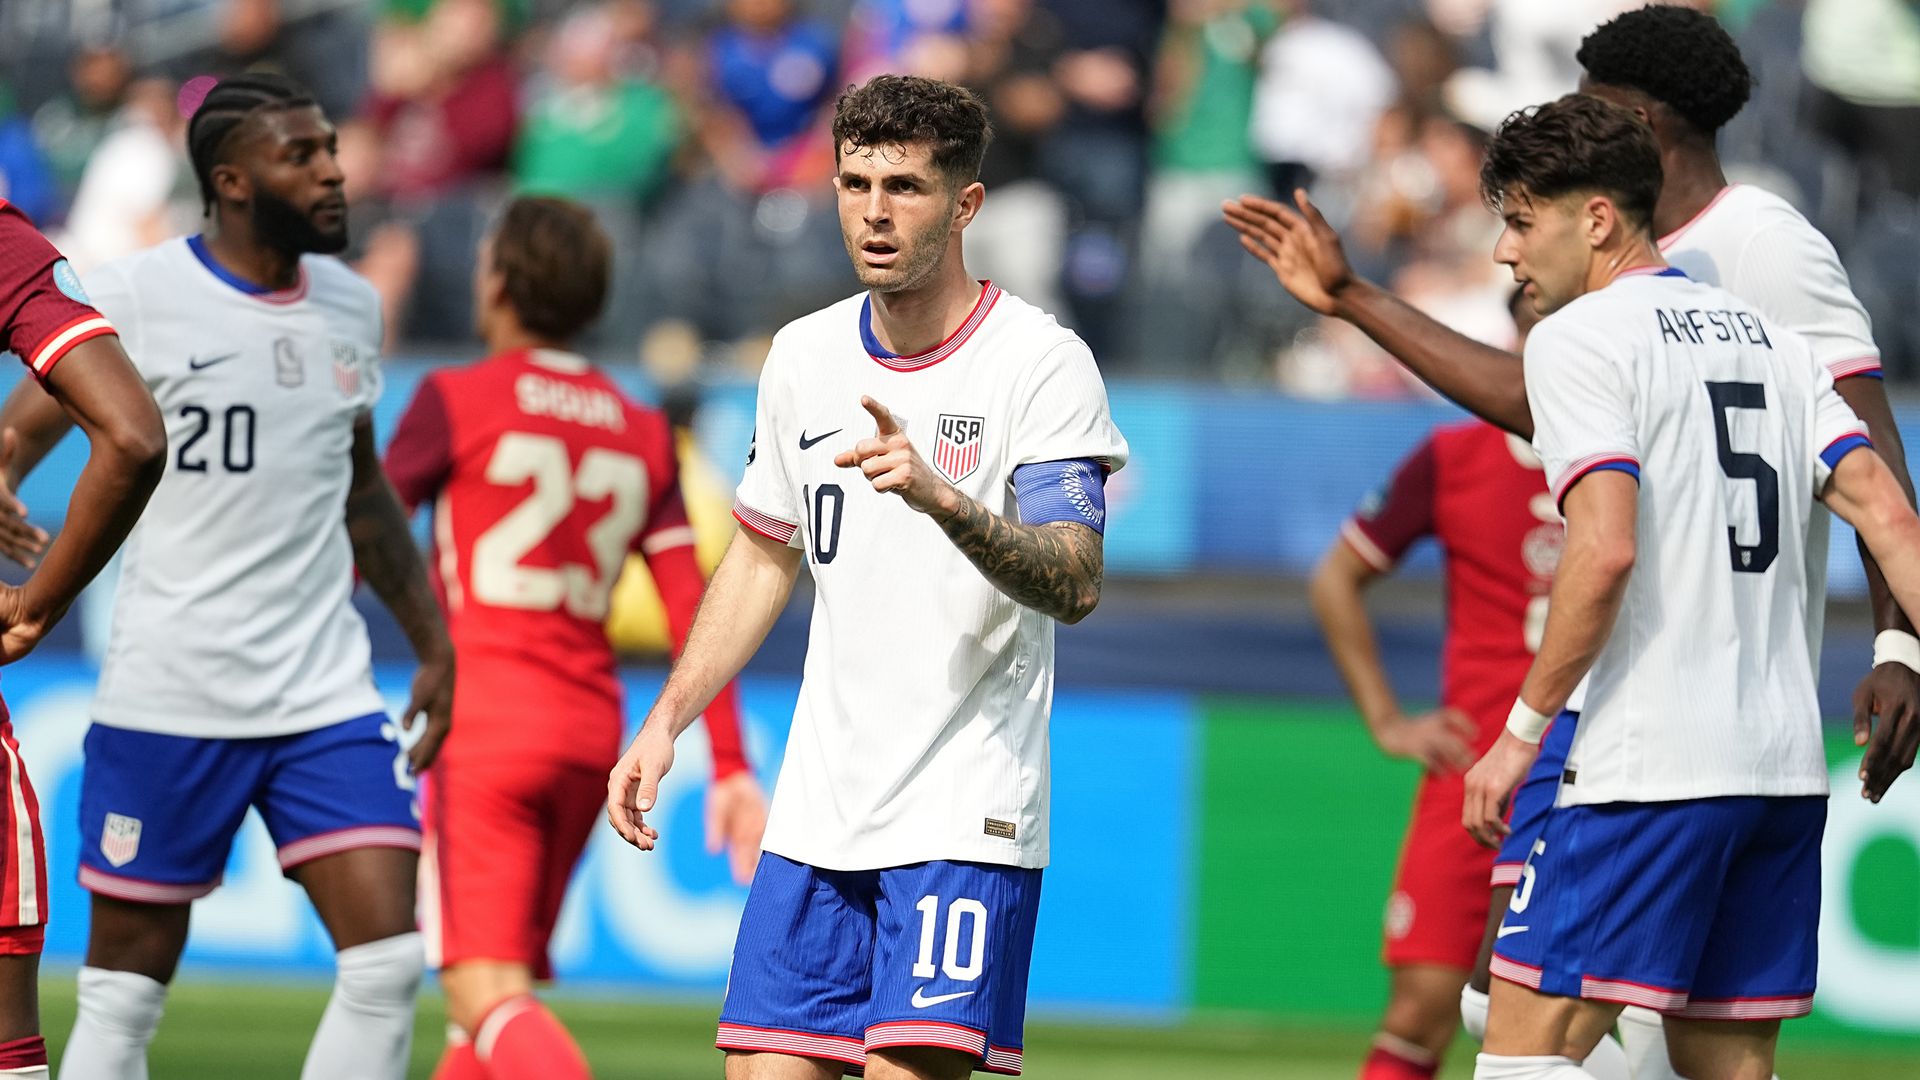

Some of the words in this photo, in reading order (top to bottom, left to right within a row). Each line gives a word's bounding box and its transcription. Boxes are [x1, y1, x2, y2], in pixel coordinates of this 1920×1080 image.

[1656, 308, 1772, 350] ARFSTEN
[177, 406, 255, 472] 20
[941, 418, 980, 445] USA
[1705, 381, 1779, 573] 5
[471, 431, 648, 622] 23
[803, 483, 844, 565] 10
[1510, 838, 1546, 915] 5
[912, 894, 988, 981] 10
